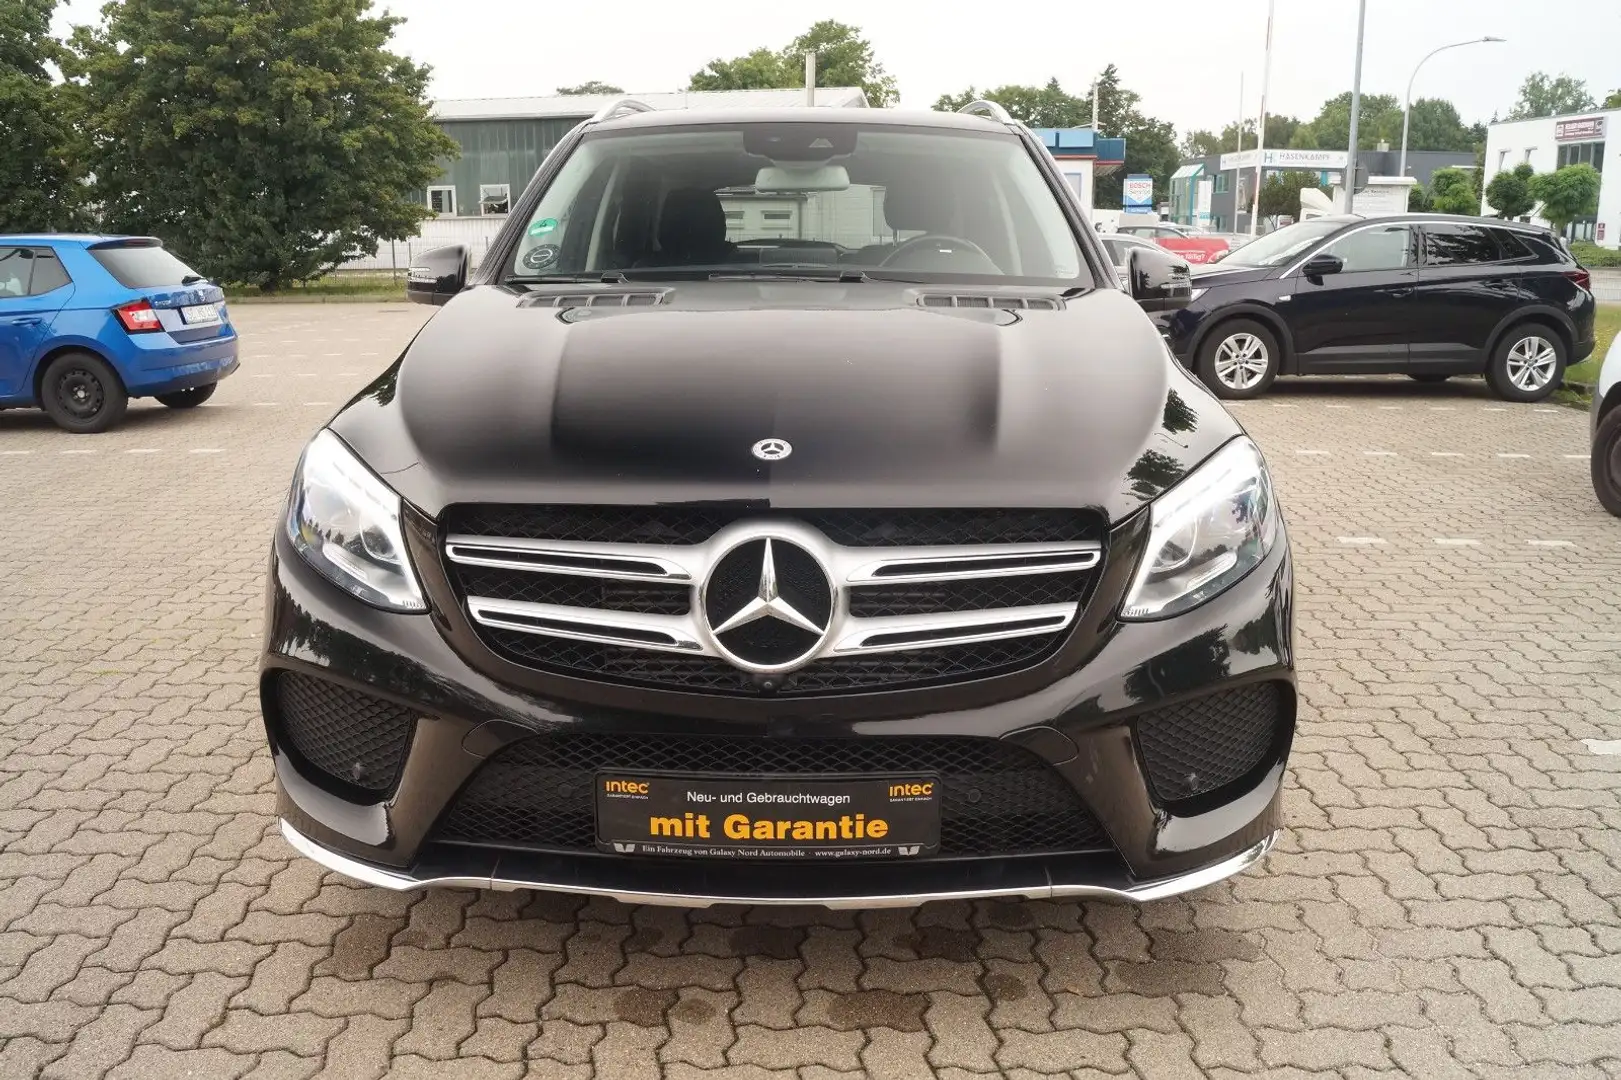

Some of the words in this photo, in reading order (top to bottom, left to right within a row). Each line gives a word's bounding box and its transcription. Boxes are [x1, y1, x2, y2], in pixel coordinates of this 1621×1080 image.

[1280, 152, 1331, 161] HASENKAMPF
[605, 780, 649, 794] intec
[889, 782, 933, 797] intec
[687, 791, 716, 803] Neu-
[720, 792, 743, 803] und
[747, 792, 851, 806] Gebrauchtwagen
[650, 812, 711, 838] mit
[723, 813, 889, 840] Garantie
[642, 844, 656, 852] Ein
[657, 845, 692, 856] Fahrzeug
[710, 847, 736, 857] Galaxy
[737, 849, 758, 857] Nord
[760, 848, 805, 858] Automobile
[814, 847, 892, 858] www.galaxy-nord.de
